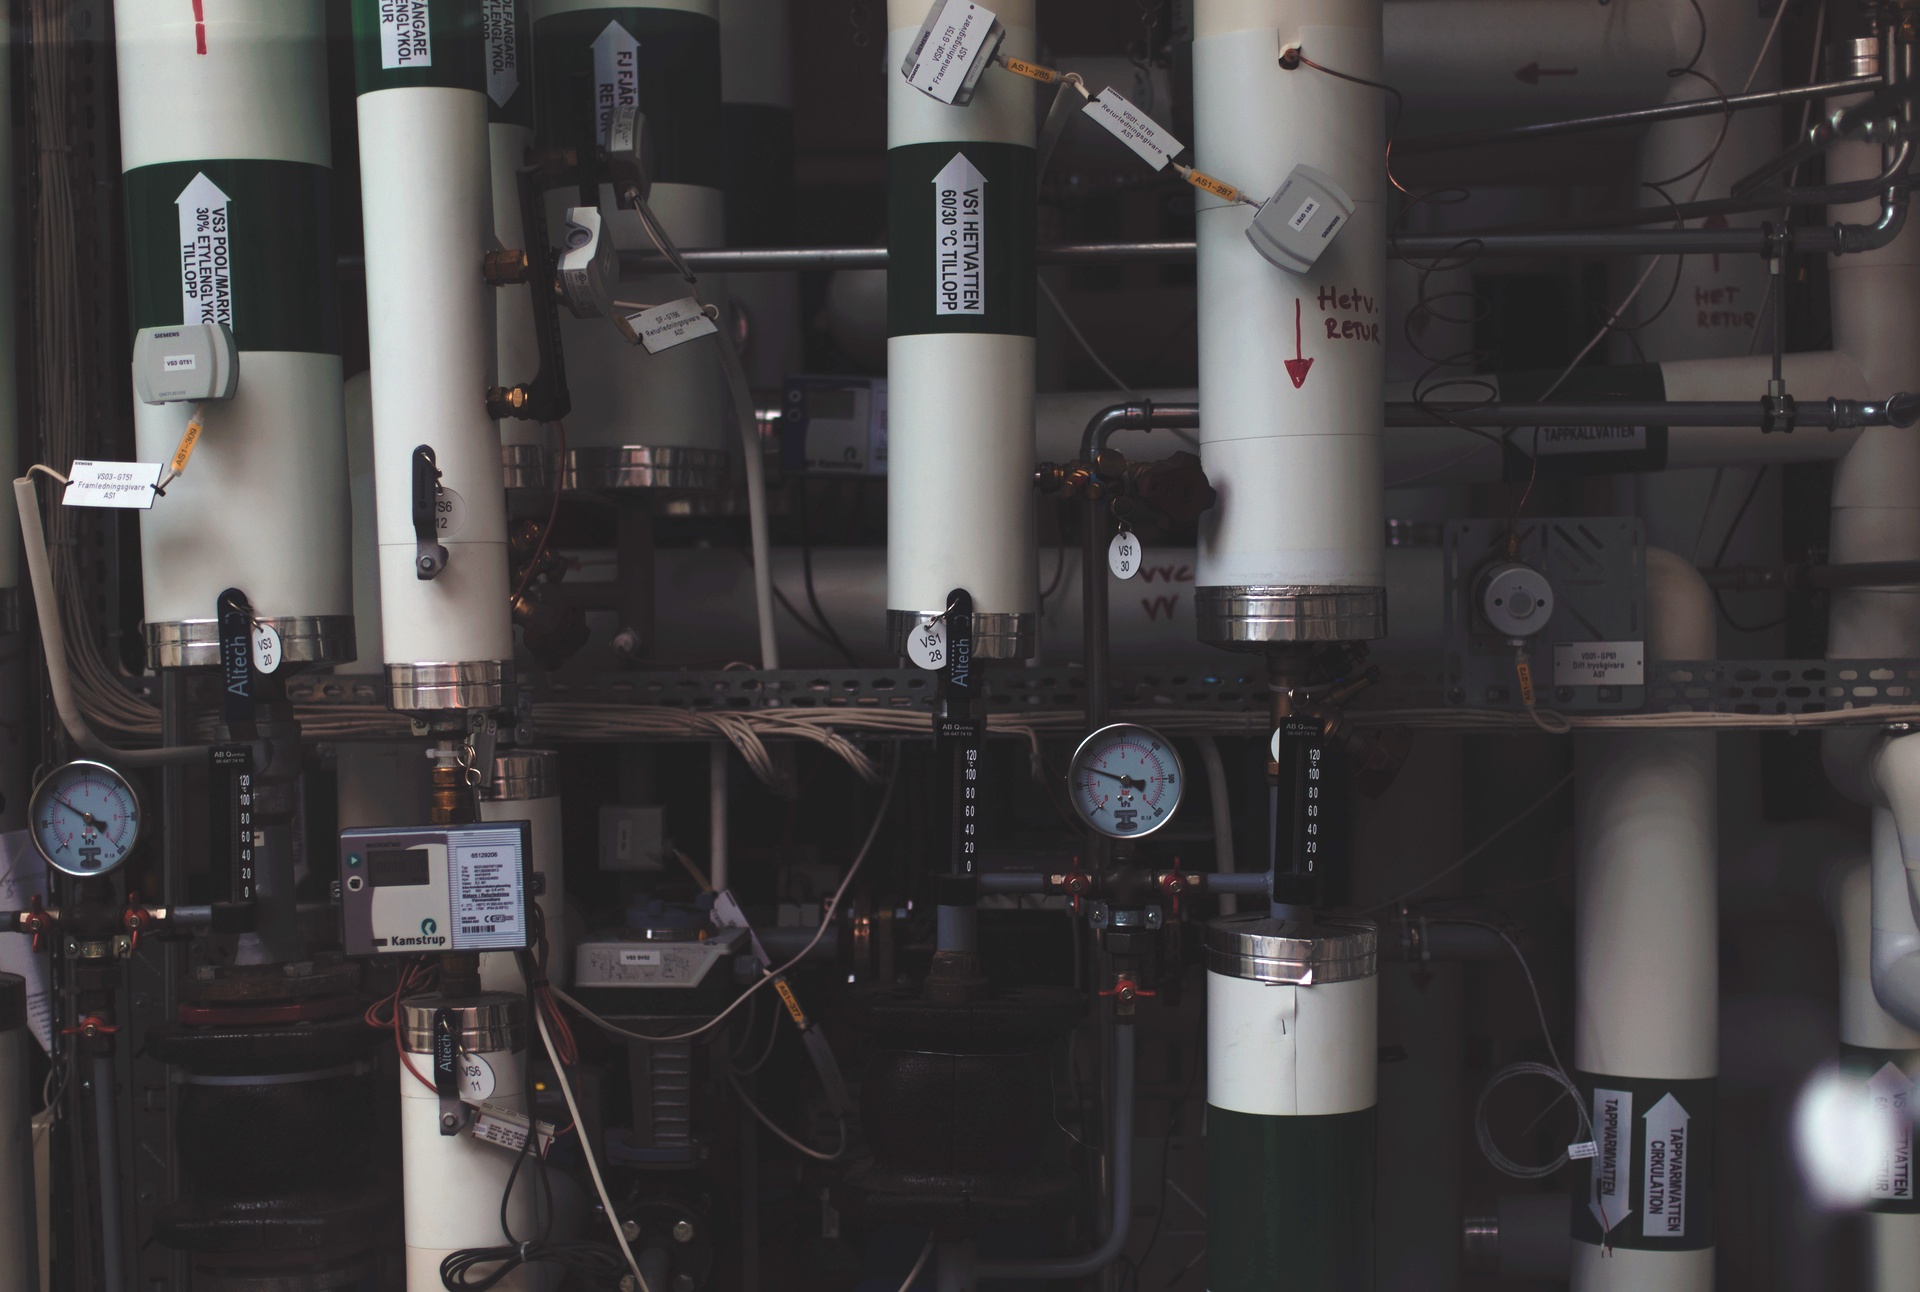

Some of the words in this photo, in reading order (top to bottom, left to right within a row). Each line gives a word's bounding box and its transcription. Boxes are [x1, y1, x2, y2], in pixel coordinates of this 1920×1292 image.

[915, 31, 931, 56] SIEMENS
[931, 26, 956, 62] VS01-GT51
[932, 14, 974, 85] Framledningsgivare
[617, 51, 632, 67] FJ
[957, 46, 969, 62] AS1
[1010, 62, 1050, 81] AS1-285
[1101, 103, 1163, 155] Returledningsgivare
[1122, 110, 1155, 138] VS01-GT61
[1120, 128, 1134, 140] AS1
[1194, 176, 1233, 197] AS1-287
[942, 189, 957, 225] 60/30
[963, 188, 978, 215] VS1
[196, 207, 208, 232] 30%
[212, 207, 226, 233] VS3
[1321, 216, 1341, 239] SIEMENS
[183, 242, 198, 299] TILLOPP
[963, 221, 979, 310] HETVATTEN
[942, 250, 958, 311] TILLOPP
[1694, 285, 1741, 307] HET
[154, 331, 180, 339] SIEMENS
[1325, 318, 1381, 345] RETUR
[175, 427, 198, 467] AS1-309
[96, 473, 133, 481] VS03-GT51
[77, 482, 146, 491] Framledningsgivare
[435, 501, 453, 513] S6
[1118, 545, 1133, 556] VS1
[1120, 561, 1130, 572] 30
[257, 638, 273, 651] VS3
[920, 633, 942, 648] VS1
[263, 654, 272, 666] 20
[929, 650, 943, 662] 28
[227, 636, 249, 697] Altech
[951, 639, 970, 688] Altech
[965, 749, 977, 761] 120
[1309, 749, 1320, 761] 120
[965, 769, 976, 780] 100
[1308, 768, 1320, 780] 100
[239, 775, 250, 787] 120
[965, 787, 975, 799] 80
[1308, 787, 1318, 799] 80
[240, 794, 250, 806] 100
[965, 805, 975, 817] 60
[1308, 805, 1318, 816] 60
[241, 813, 250, 825] 80
[964, 824, 974, 835] 40
[1307, 823, 1317, 835] 40
[241, 831, 250, 843] 60
[964, 842, 974, 854] 20
[1307, 842, 1317, 853] 20
[241, 849, 251, 861] 40
[966, 860, 972, 872] 0
[1308, 860, 1314, 872] 0
[242, 868, 251, 880] 20
[245, 886, 249, 898] 0
[391, 935, 446, 947] Kamstrup
[778, 985, 802, 1017] AS1-377
[439, 1034, 453, 1073] Altech
[461, 1066, 481, 1077] VS6
[470, 1081, 481, 1092] 11
[1603, 1098, 1618, 1196] TAPPVARMVATTEN
[1649, 1140, 1666, 1215] CIRKULATION
[1668, 1127, 1683, 1232] TAPPVARMVATTEN
